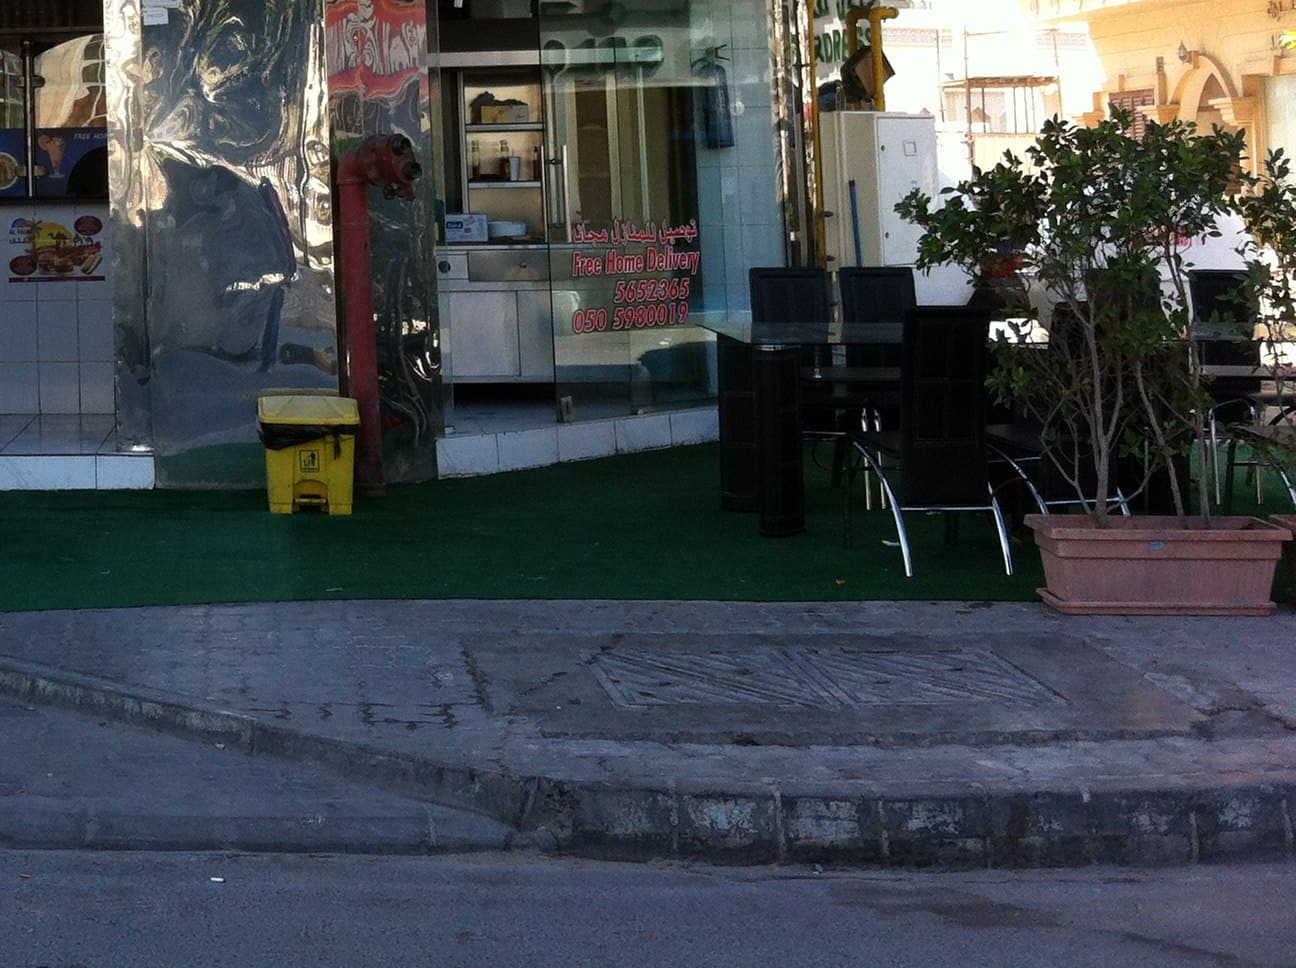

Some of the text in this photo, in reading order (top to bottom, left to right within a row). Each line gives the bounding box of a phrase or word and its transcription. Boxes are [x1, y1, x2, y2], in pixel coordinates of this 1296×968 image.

[572, 245, 700, 276] Free Home Delivery
[614, 277, 690, 304] 5652365
[573, 302, 689, 333] 050 5980019
